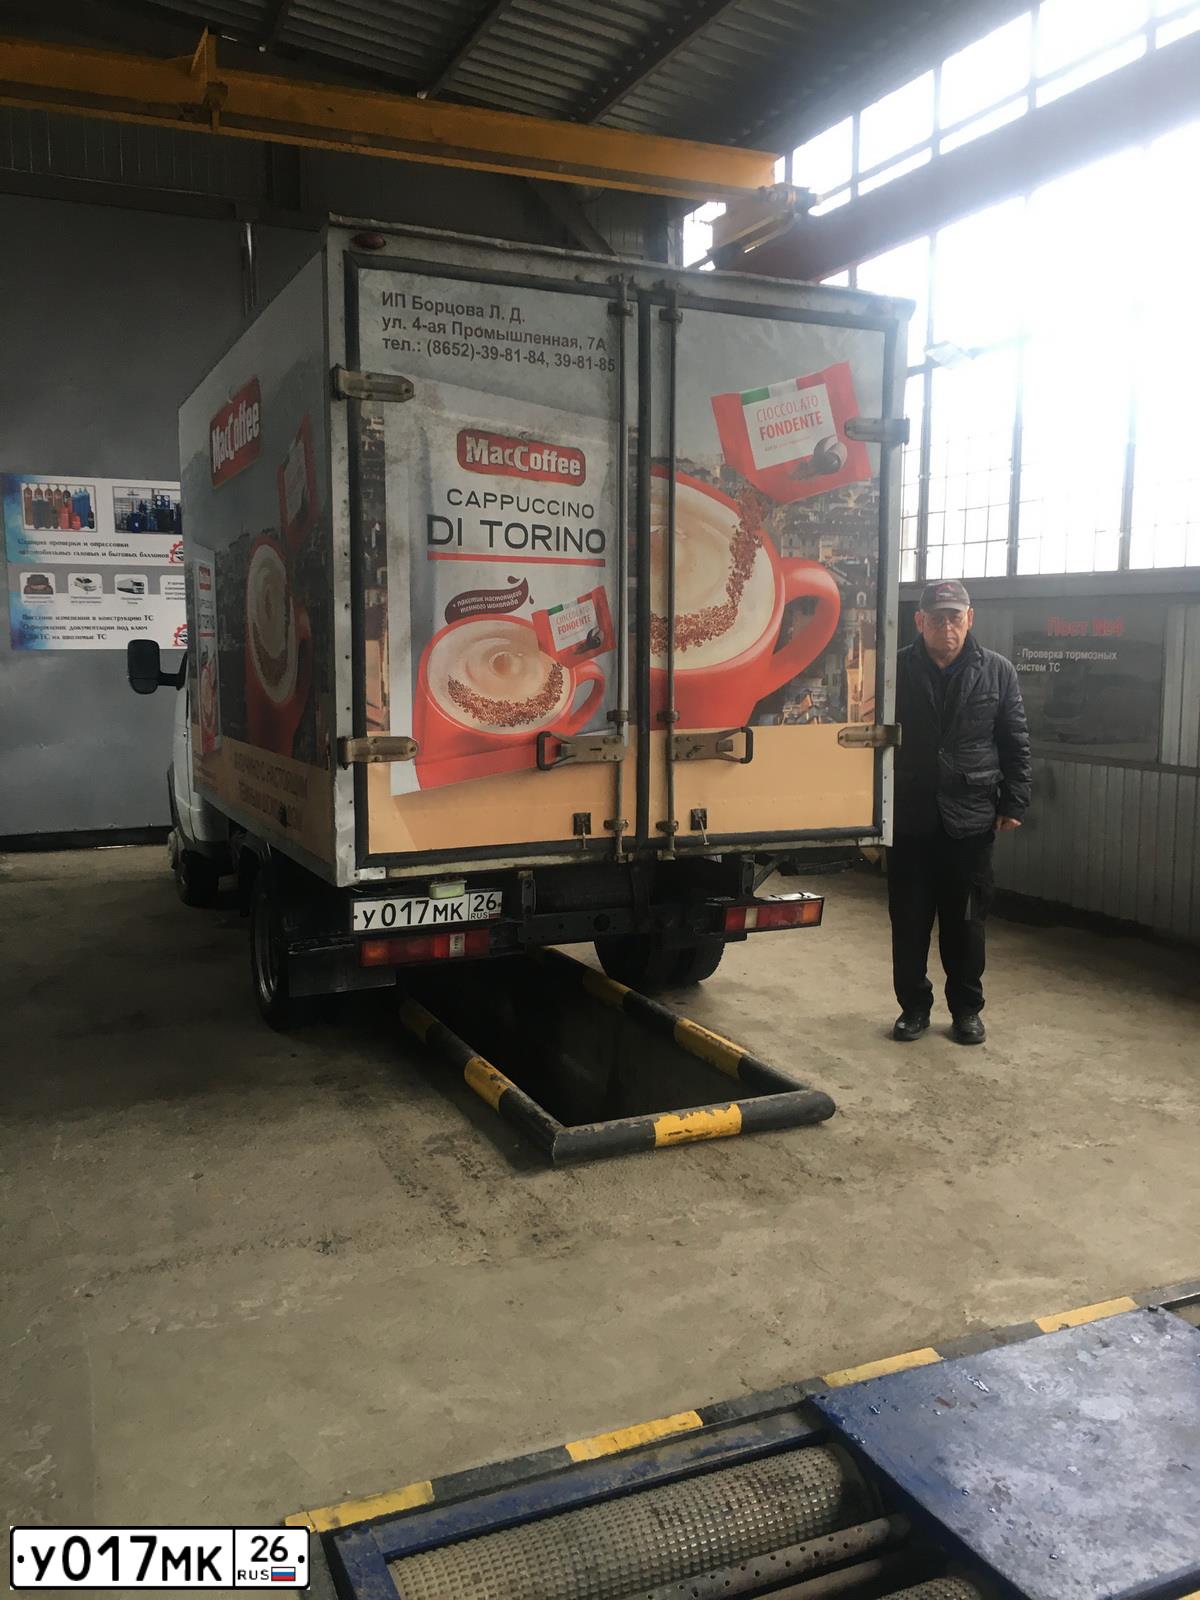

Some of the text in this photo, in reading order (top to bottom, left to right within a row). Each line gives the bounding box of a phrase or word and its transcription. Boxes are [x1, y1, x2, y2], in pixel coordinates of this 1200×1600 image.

[382, 291, 526, 325] ИП Борцова Л. Д.
[382, 316, 608, 352] ул. 4-ая Промышленная, 7А
[382, 337, 616, 373] тел.: (8652)-39-81-84, 39-81-85
[756, 395, 819, 423] CIOCCOLATO
[211, 400, 260, 473] MacCoffee
[759, 411, 824, 441] FONDENTE
[465, 436, 581, 476] MacCoffee
[446, 488, 595, 519] CAPPUCCINO
[426, 513, 606, 554] DI TORINO
[143, 614, 154, 622] ТС
[557, 614, 592, 635] FONDENTE
[1016, 662, 1061, 673] систем ТС
[1022, 648, 1063, 661] Проверка
[1065, 650, 1118, 662] тормозных
[362, 893, 497, 929] У017МК 26
[470, 911, 489, 920] RUS
